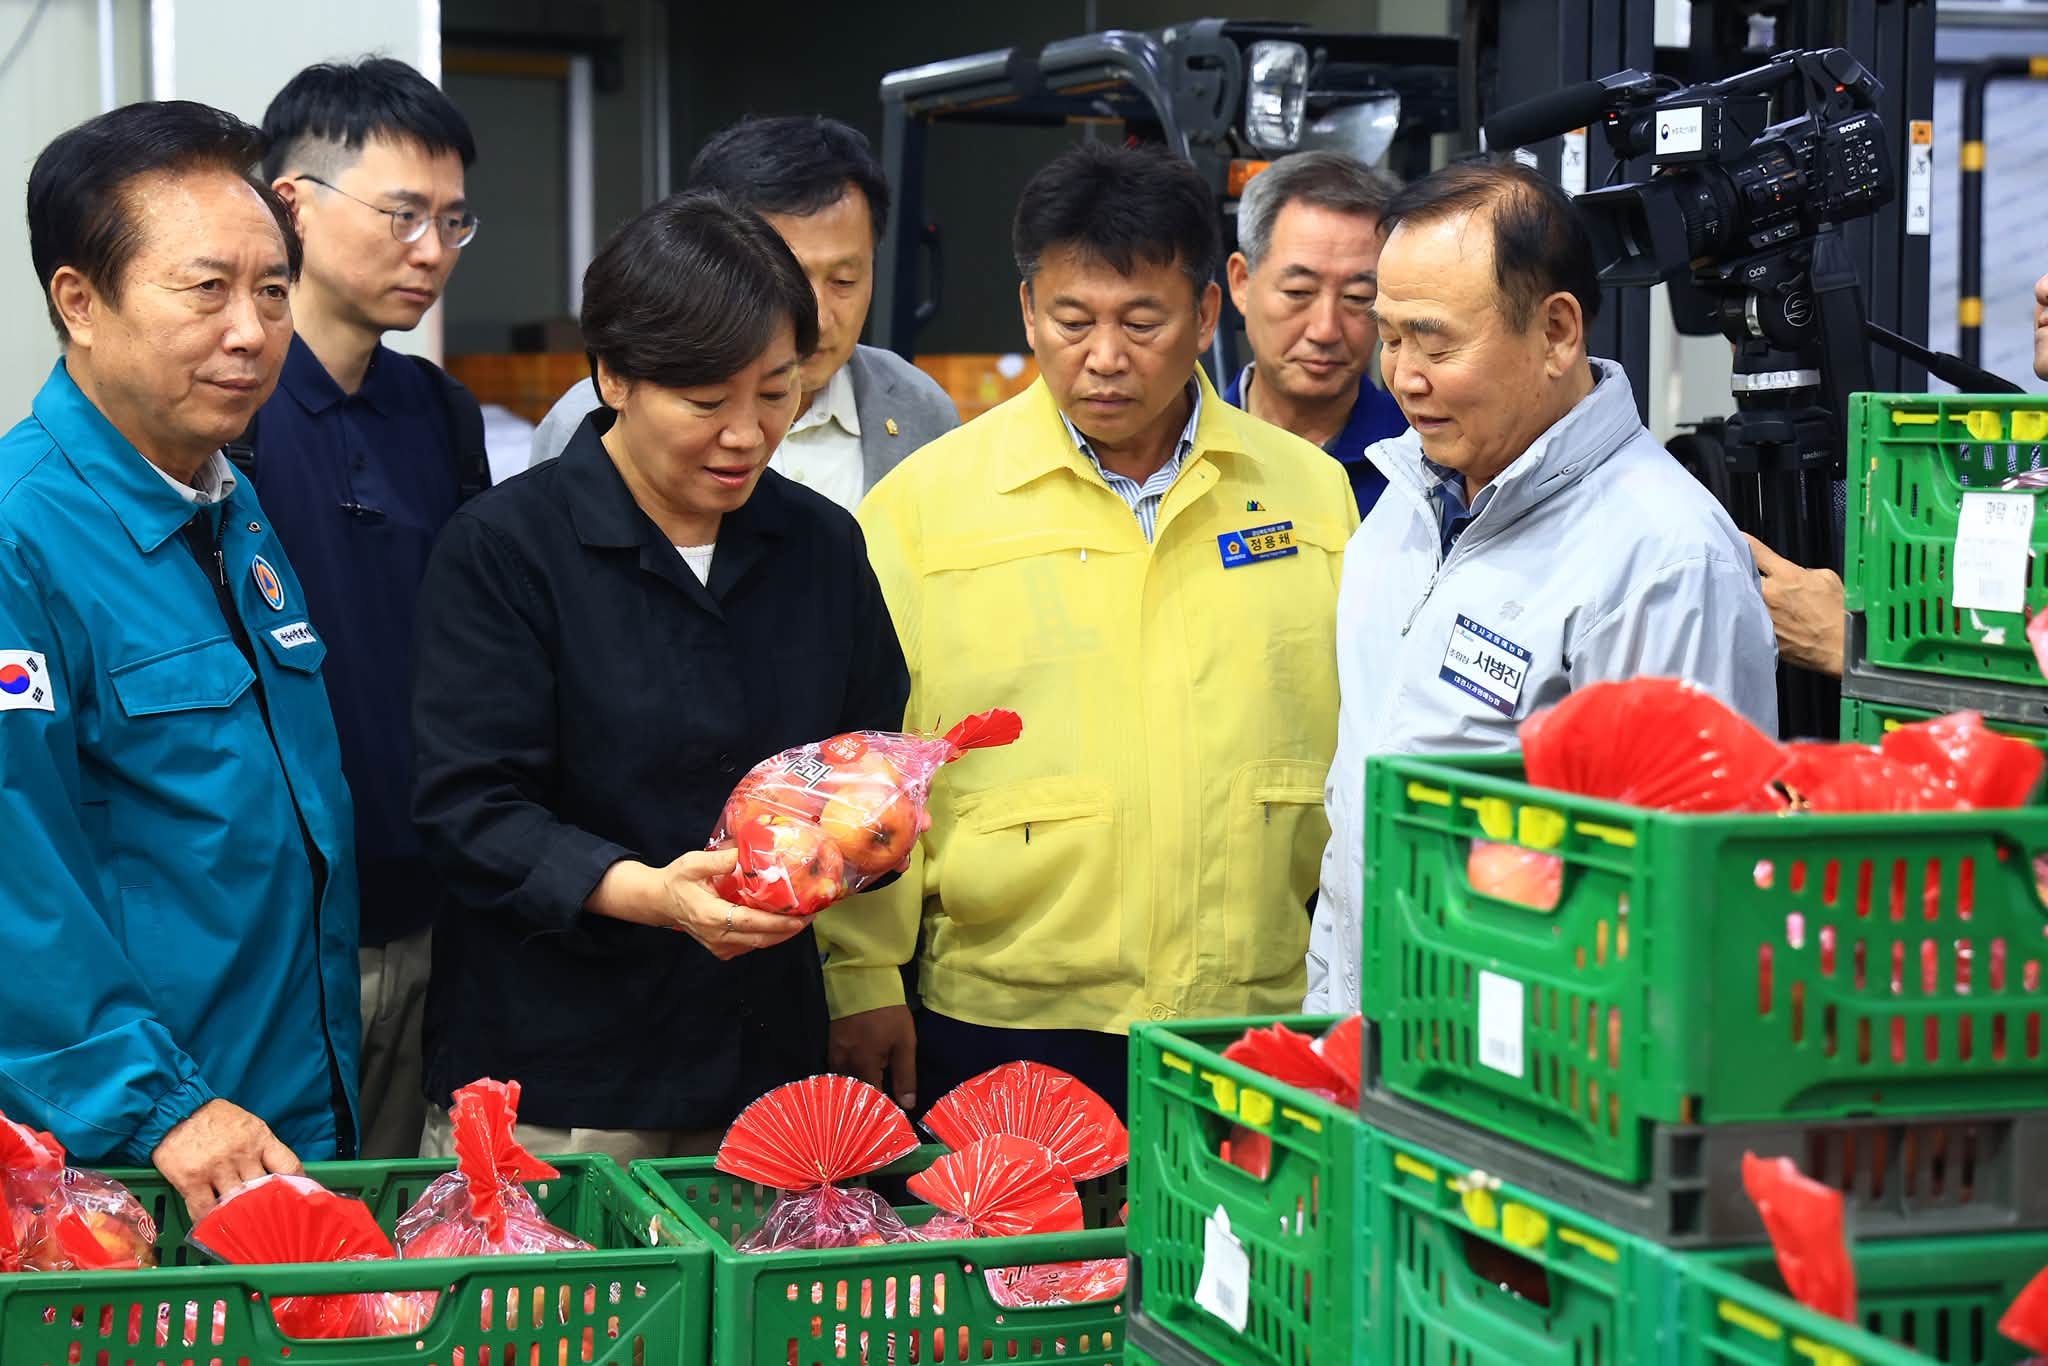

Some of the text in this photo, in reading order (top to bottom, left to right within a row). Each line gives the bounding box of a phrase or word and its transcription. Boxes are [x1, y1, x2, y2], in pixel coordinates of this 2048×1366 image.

[1838, 119, 1867, 134] SONY
[1749, 265, 1767, 278] ace
[1250, 532, 1291, 552] 정용채
[1473, 651, 1522, 690] 서병진
